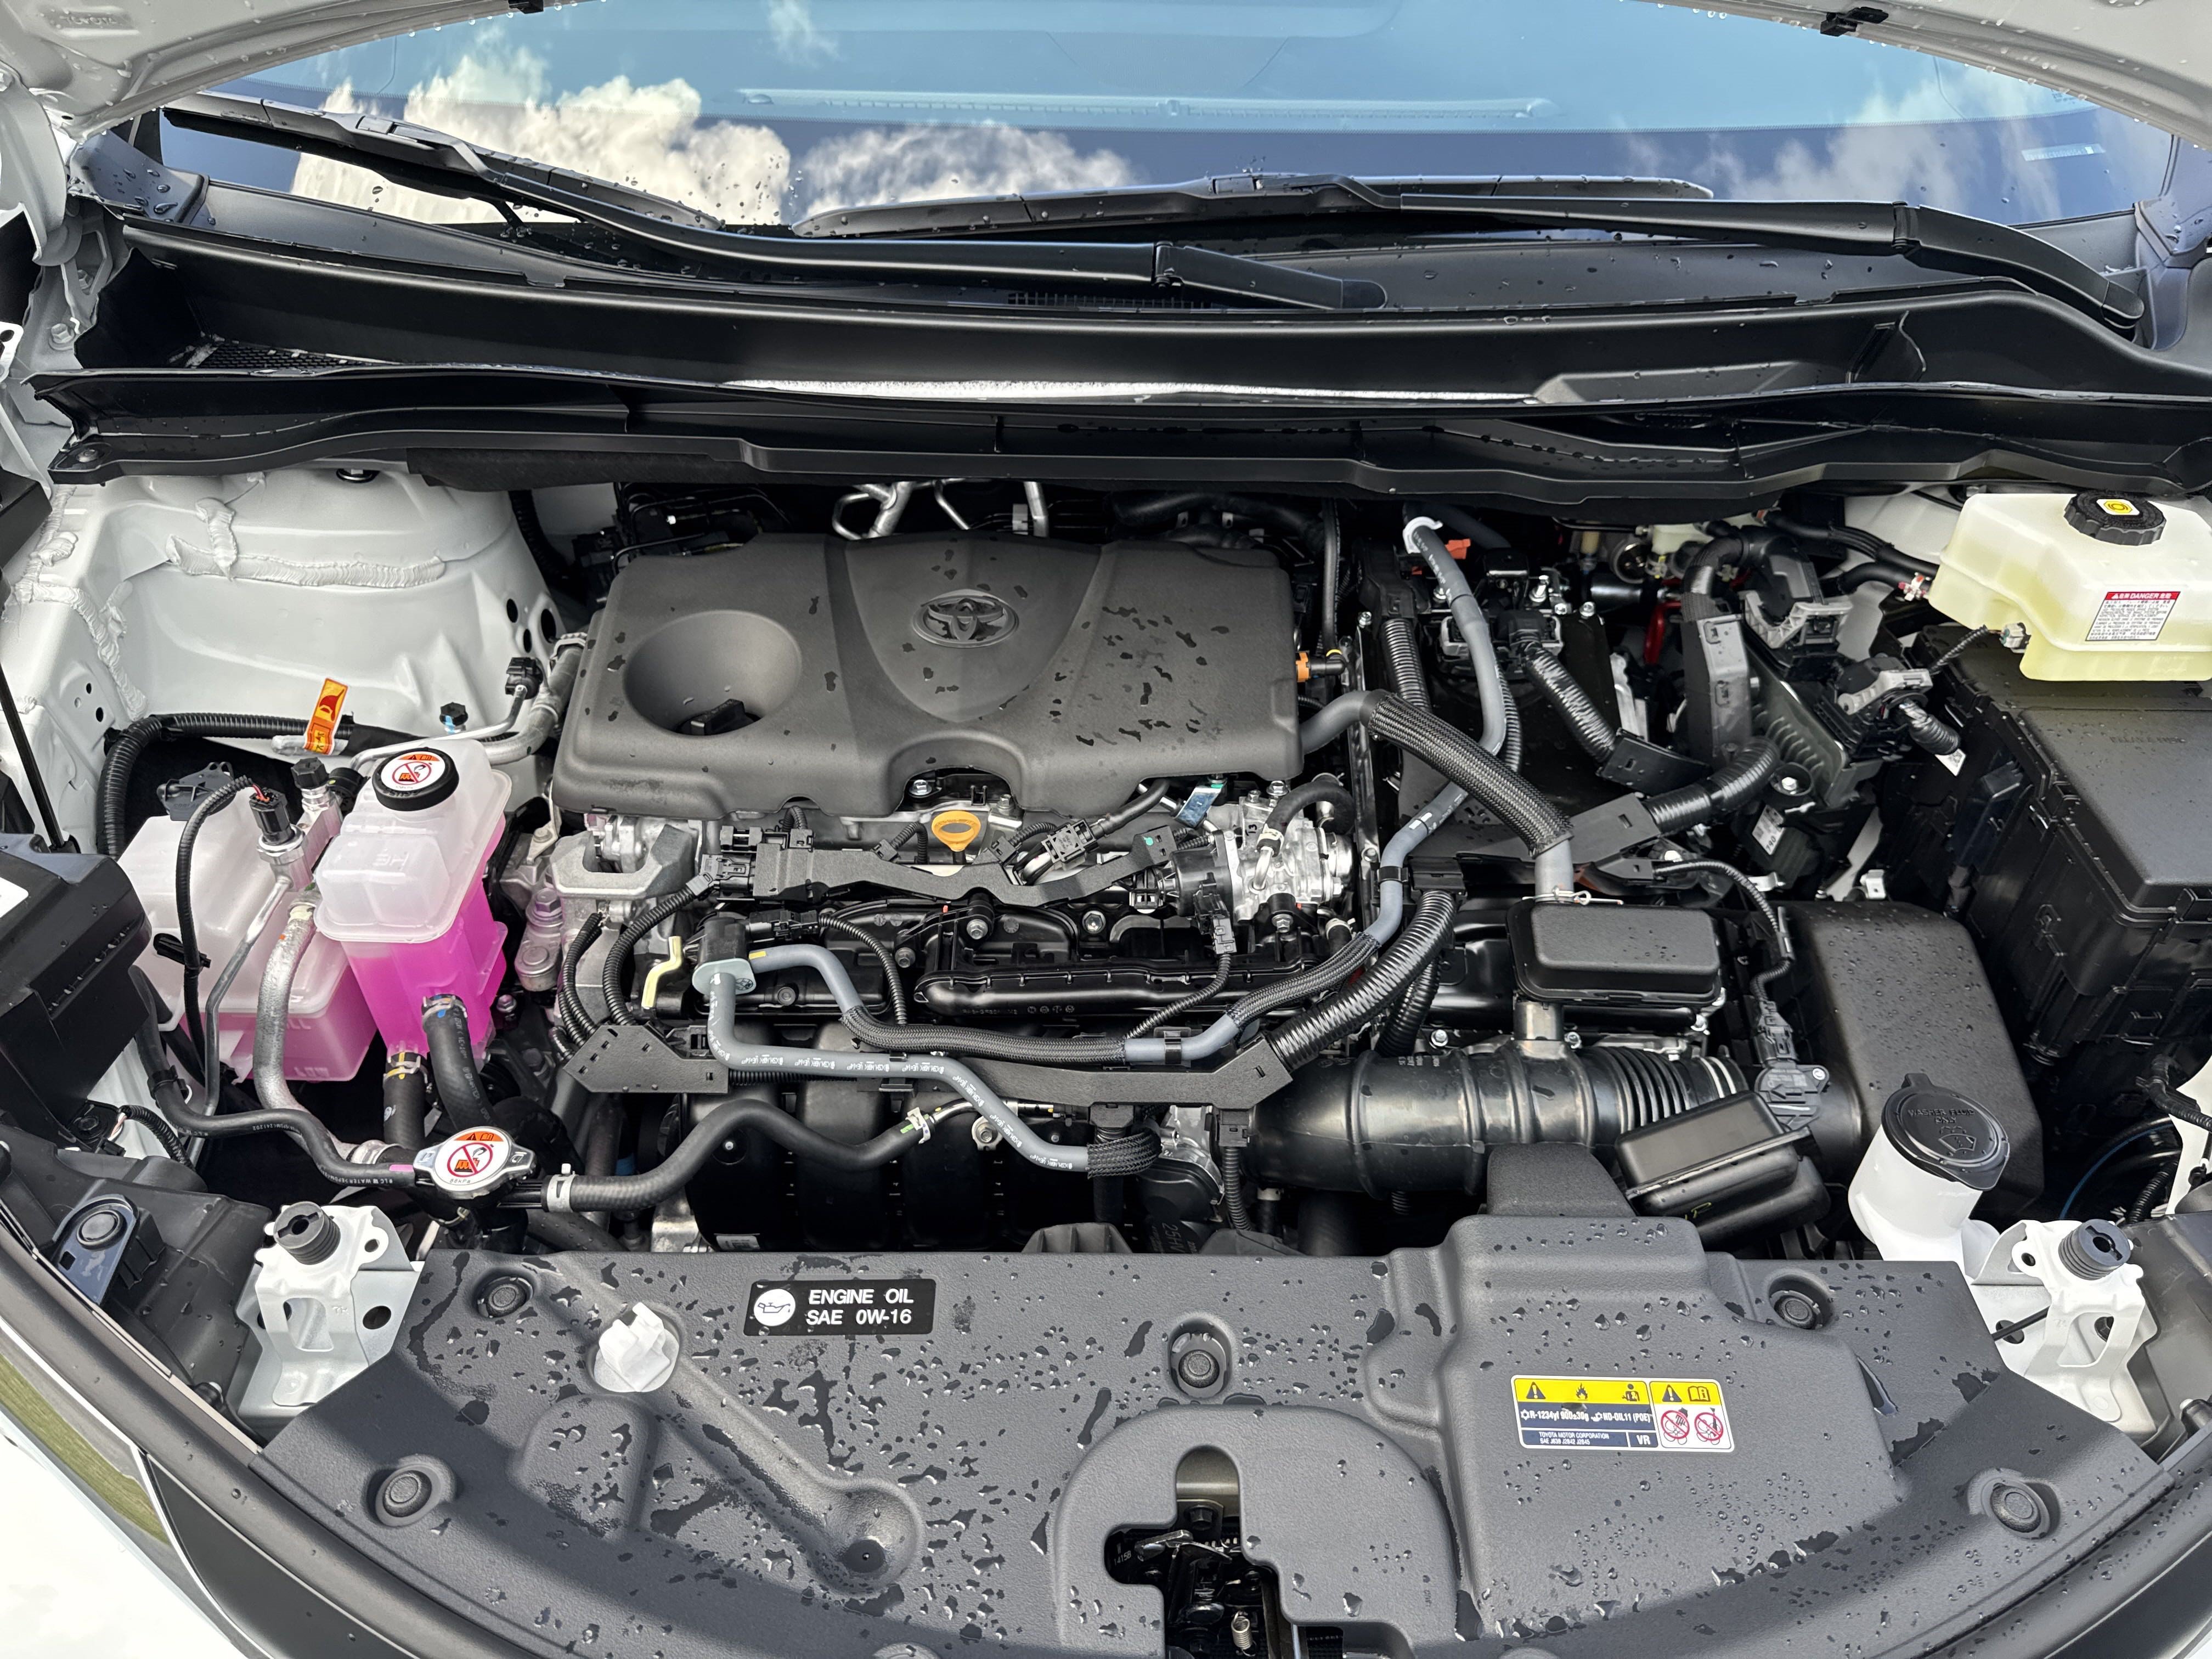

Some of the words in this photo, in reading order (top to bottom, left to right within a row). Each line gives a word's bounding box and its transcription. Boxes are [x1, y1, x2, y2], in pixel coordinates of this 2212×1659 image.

[809, 1289, 874, 1305] ENGINE
[885, 1288, 913, 1304] OIL
[806, 1310, 843, 1325] SAE
[856, 1309, 911, 1324] 0W-16
[1530, 1410, 1559, 1421] R-1234yf
[1560, 1411, 1589, 1421] 900±30g
[1602, 1412, 1632, 1421] ND-OIL11
[1633, 1413, 1651, 1423] (POE)
[1636, 1435, 1651, 1445] VR
